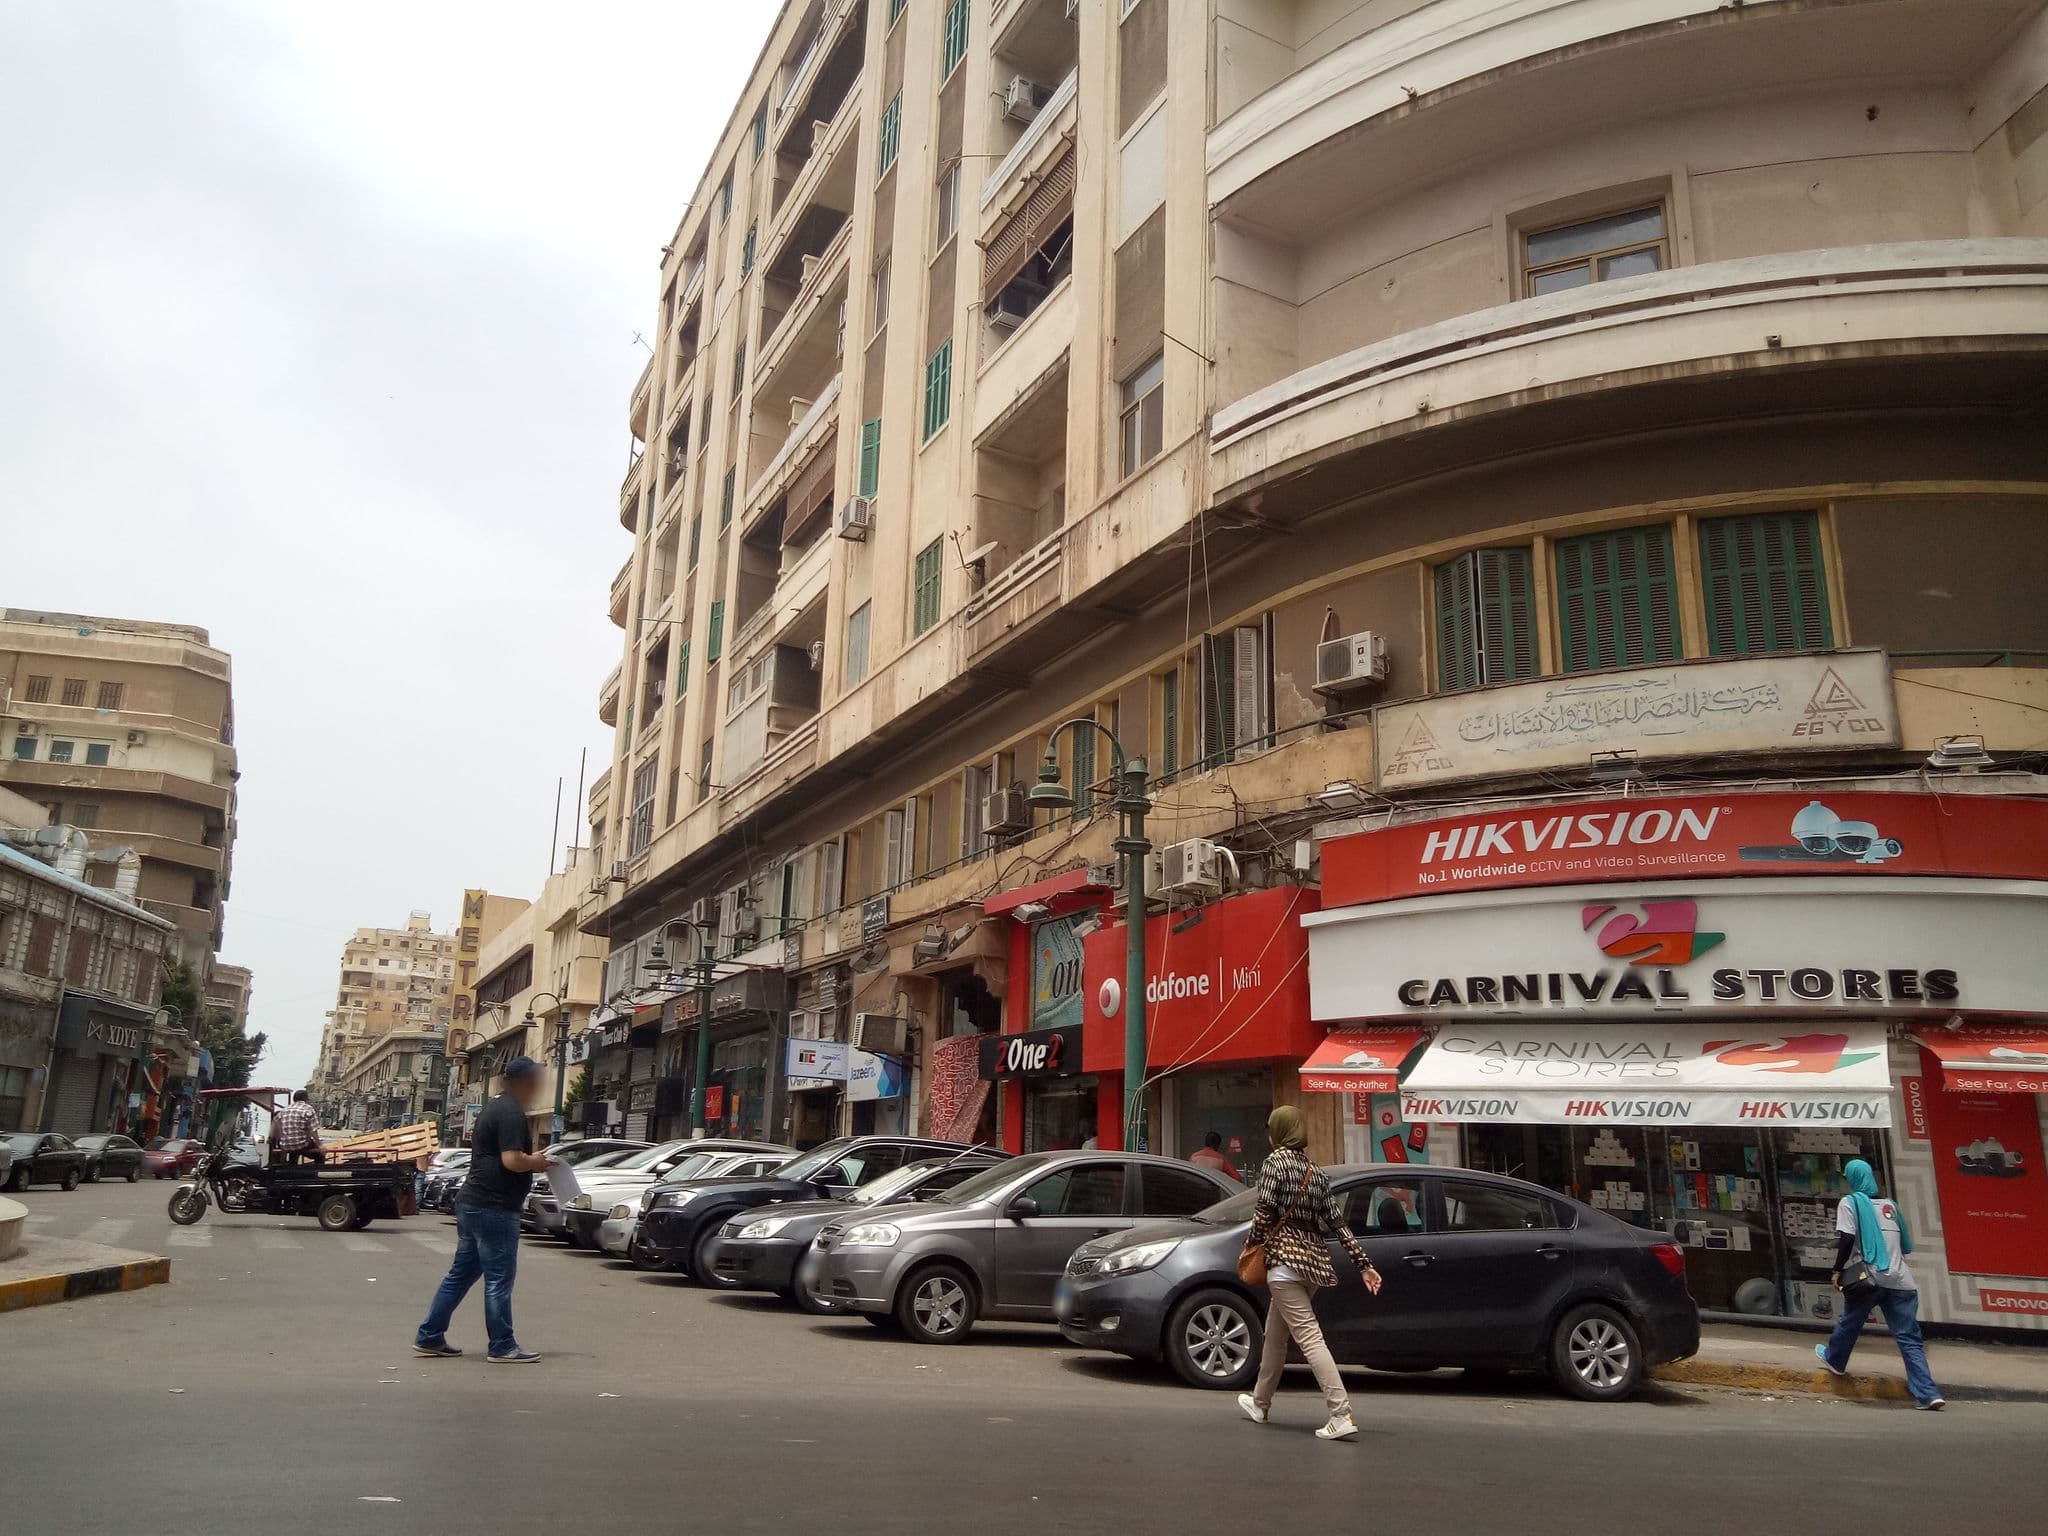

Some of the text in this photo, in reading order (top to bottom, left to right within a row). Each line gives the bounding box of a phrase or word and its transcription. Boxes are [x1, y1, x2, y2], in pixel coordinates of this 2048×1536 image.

[1792, 718, 1885, 736] EGYCO
[1384, 758, 1454, 777] EGYCO
[1420, 807, 1719, 863] HIKVISION
[1418, 852, 1726, 884] No.1 Worldwide CCTV and Video Surveillance
[449, 893, 483, 1054] METRO
[1126, 964, 1261, 1003] dafone Mini
[1398, 968, 1960, 1006] CARNIVAL STORES
[1441, 1036, 1683, 1060] CARNIVAL
[1478, 1059, 1680, 1078] STORES
[1308, 1079, 1389, 1090] See Far, Go Further
[1956, 1079, 1983, 1089] See
[2016, 1080, 2039, 1091] Go
[1357, 1091, 1367, 1121] Leno
[1403, 1099, 1518, 1117] HIKVISION
[1565, 1100, 1692, 1118] HIKVISION
[1739, 1101, 1879, 1120] HIKVISION
[1909, 1081, 1925, 1135] Lenovo
[1986, 1293, 2048, 1311] Lenovo
